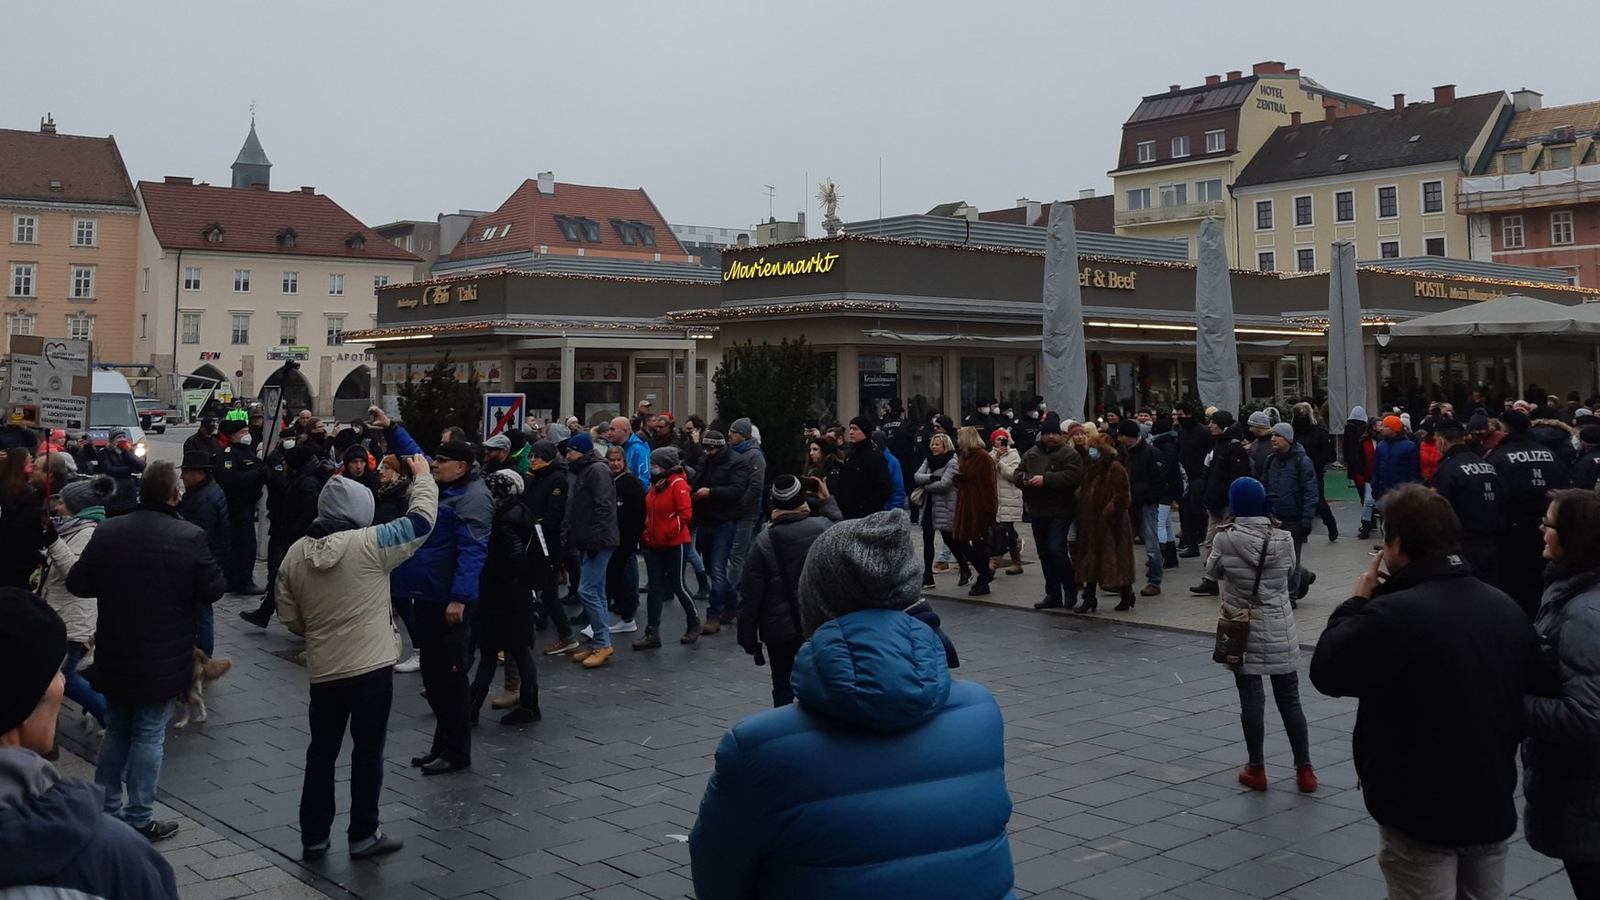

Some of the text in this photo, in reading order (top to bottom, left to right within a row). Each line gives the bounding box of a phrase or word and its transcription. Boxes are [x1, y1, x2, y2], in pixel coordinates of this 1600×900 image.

[1260, 85, 1284, 98] HOTEL
[1256, 98, 1288, 114] ZENTRAL
[723, 252, 839, 281] Marienmarkt
[1093, 269, 1106, 288] &
[1108, 270, 1137, 290] Beef
[456, 284, 478, 302] Taki
[1415, 281, 1447, 298] POSTL
[200, 351, 221, 360] EVN
[1507, 450, 1554, 463] POLIZEI
[1533, 468, 1542, 479] N
[1484, 482, 1492, 491] N
